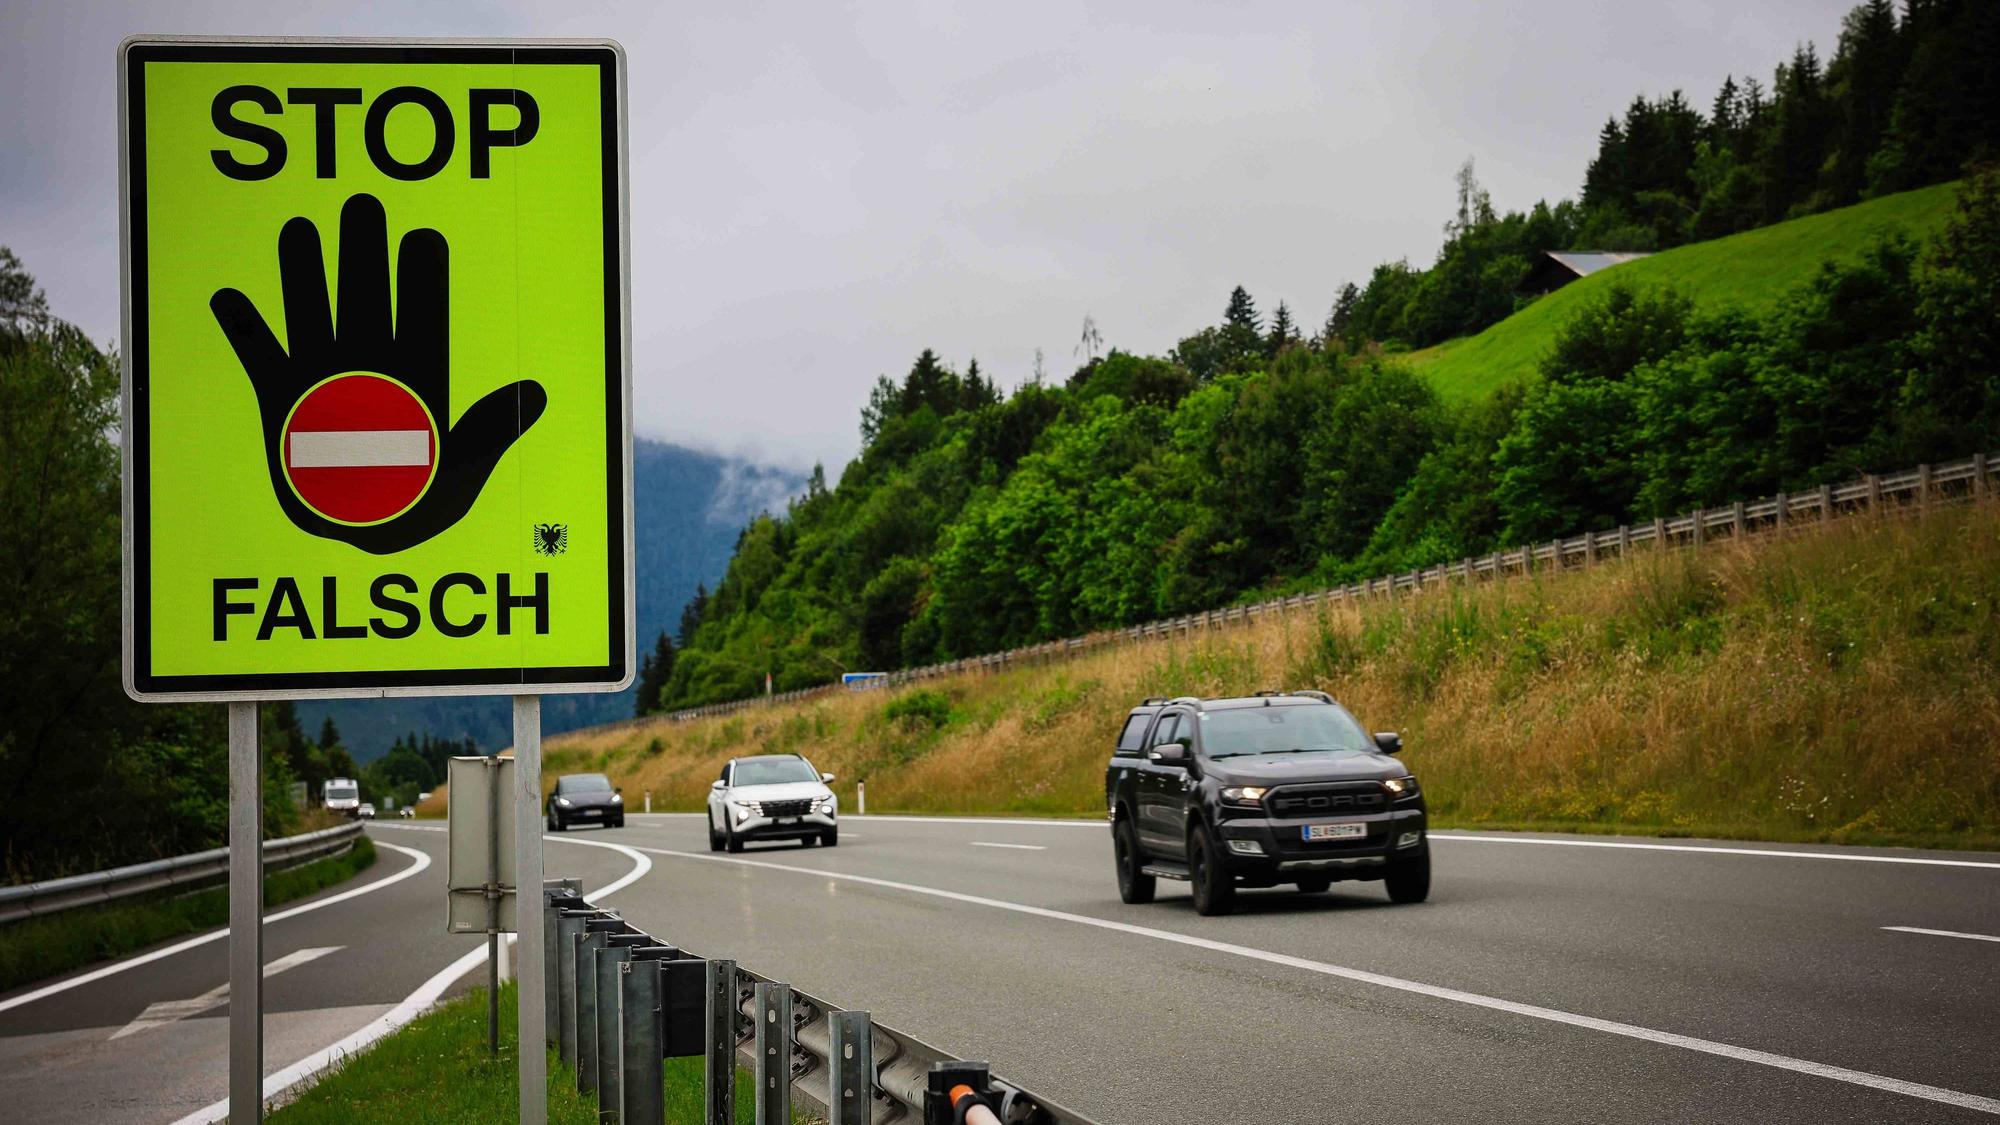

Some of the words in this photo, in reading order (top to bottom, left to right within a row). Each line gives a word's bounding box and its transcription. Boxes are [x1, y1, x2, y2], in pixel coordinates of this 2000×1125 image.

[210, 84, 540, 182] STOP
[212, 572, 550, 642] FALSCH
[1275, 794, 1384, 809] FORD
